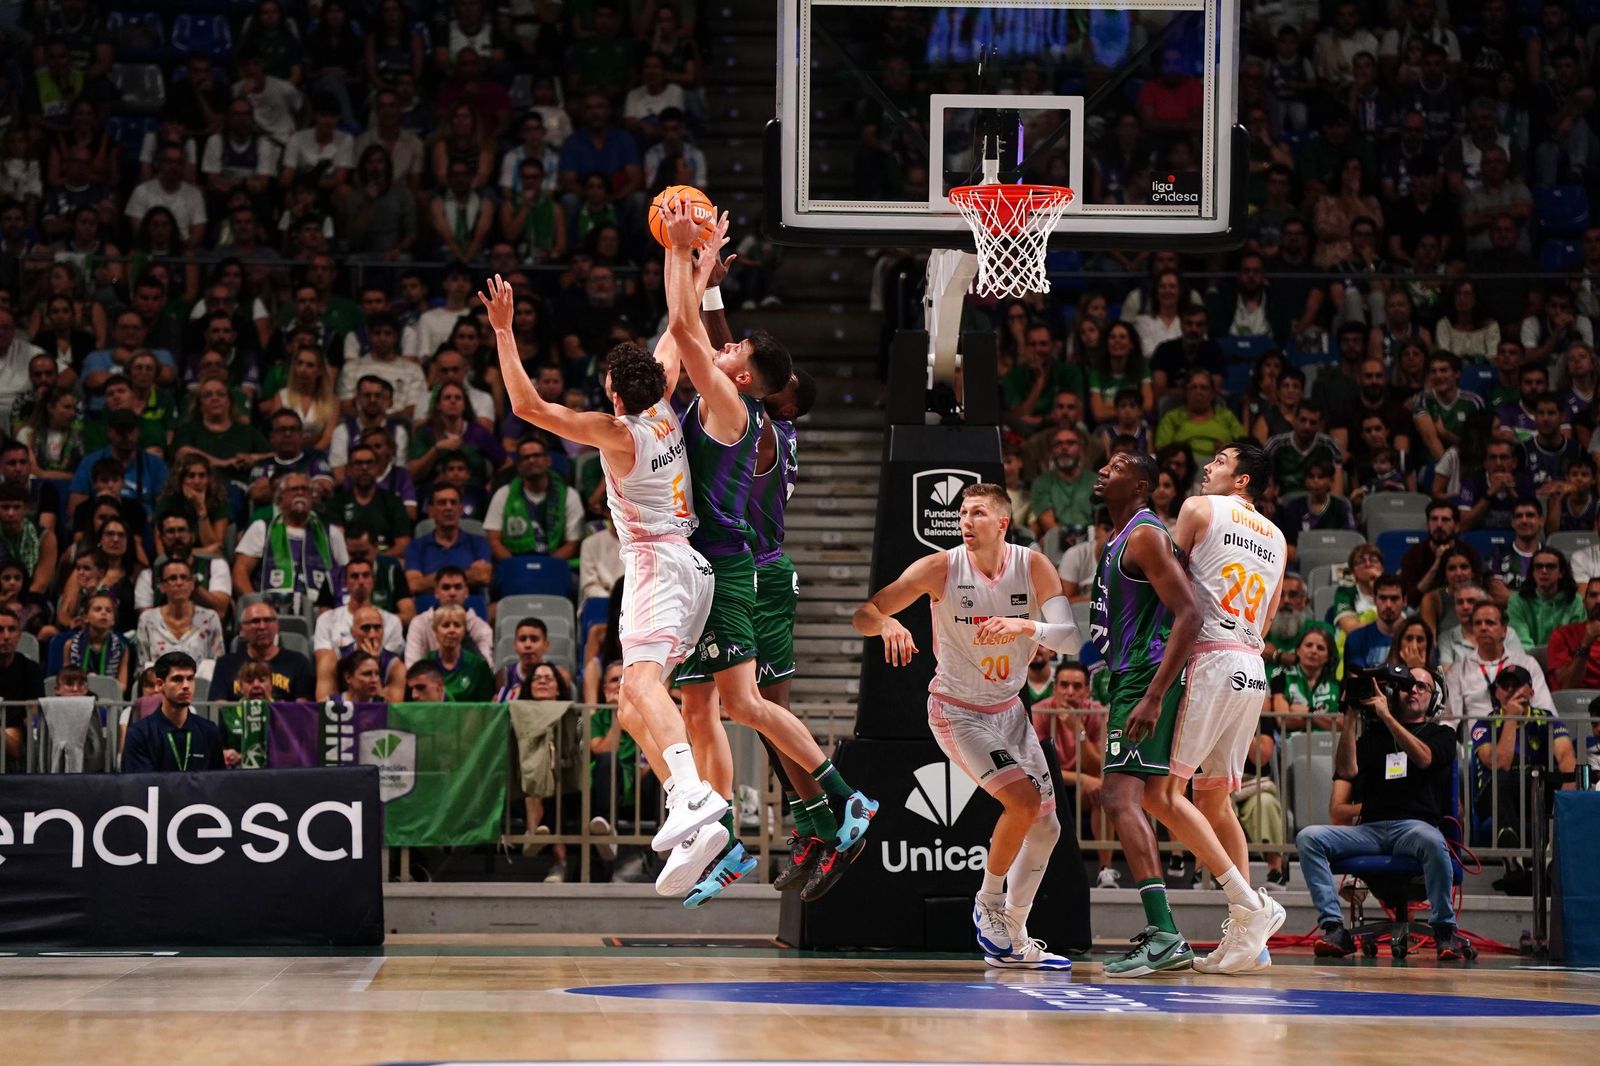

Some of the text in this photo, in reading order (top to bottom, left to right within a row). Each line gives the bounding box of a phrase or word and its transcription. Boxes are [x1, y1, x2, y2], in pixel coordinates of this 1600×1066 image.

[1152, 181, 1173, 192] liga
[1152, 191, 1198, 201] endesa
[672, 471, 691, 518] 5
[1231, 508, 1274, 539] ORIOLA
[1220, 562, 1266, 624] 29
[981, 655, 1010, 682] 20
[325, 697, 354, 766] NIC
[0, 786, 363, 869] ndesa
[881, 838, 993, 872] Unica
